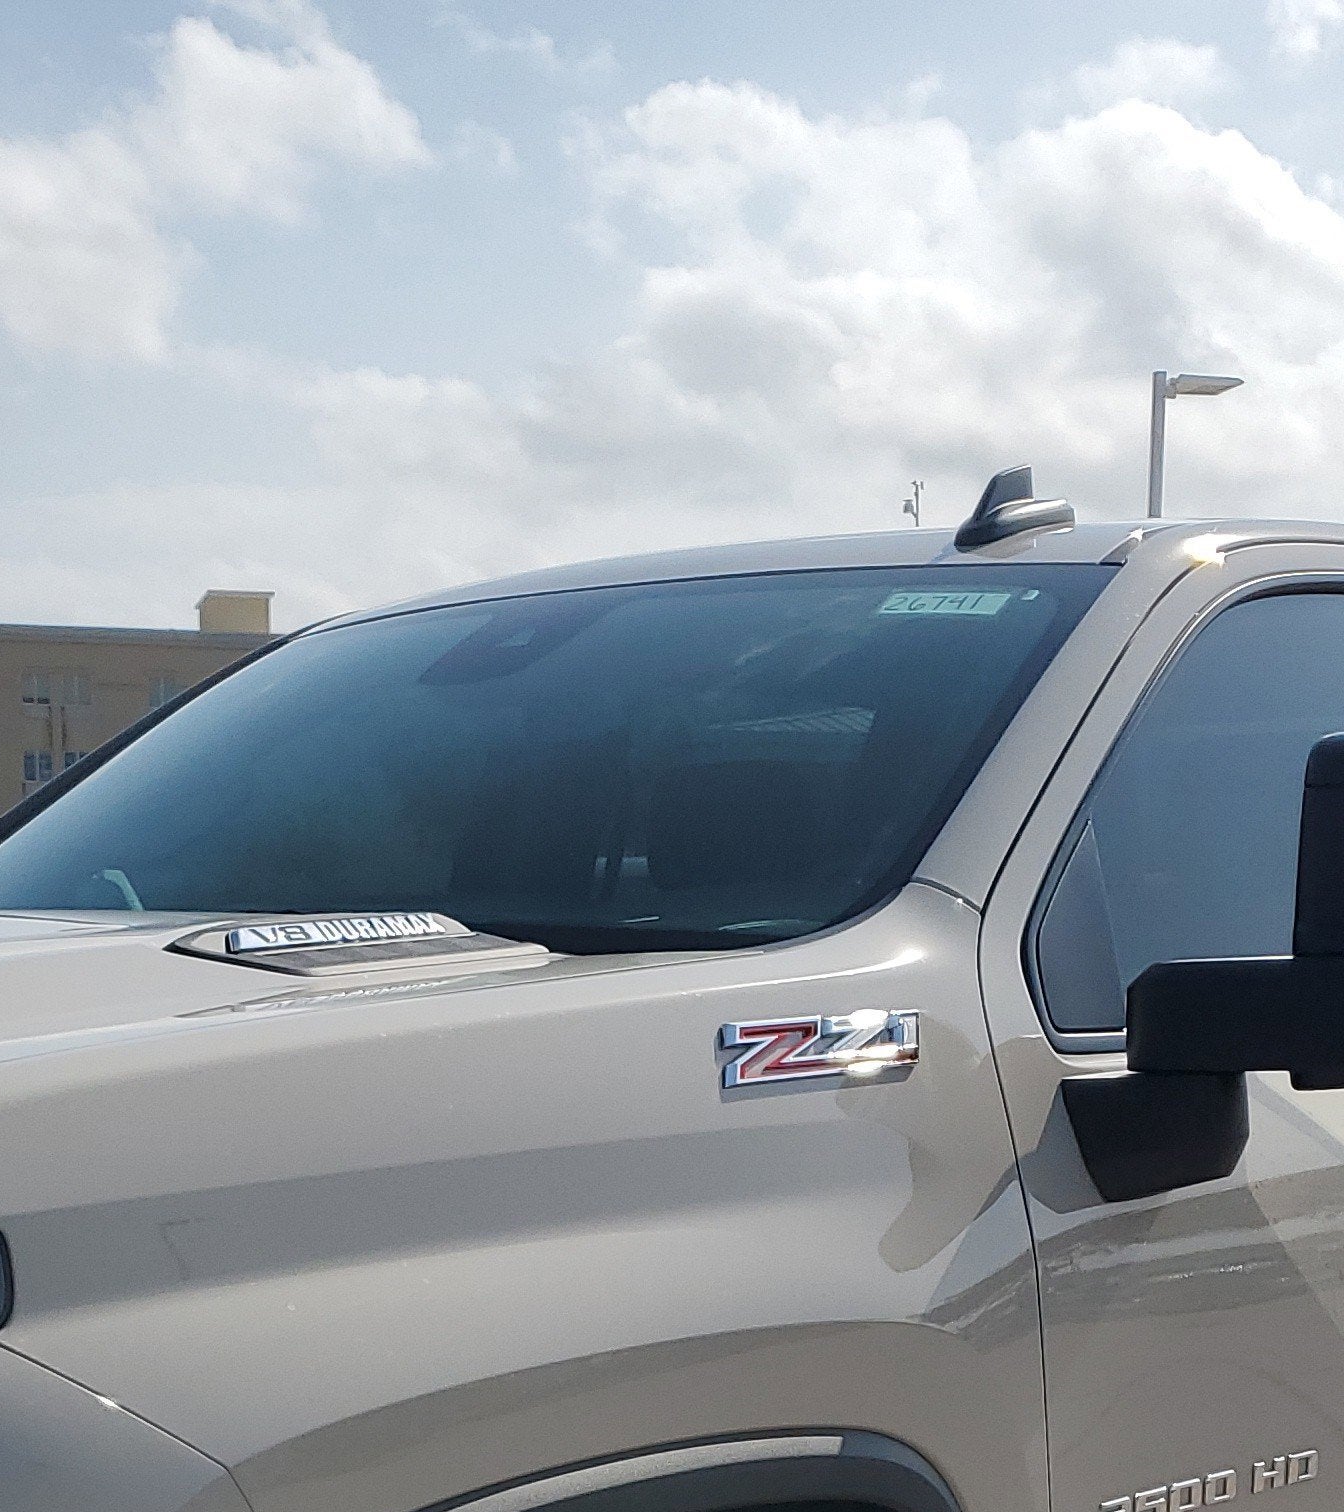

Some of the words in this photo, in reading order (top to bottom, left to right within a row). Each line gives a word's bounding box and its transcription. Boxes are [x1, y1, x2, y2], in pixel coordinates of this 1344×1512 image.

[884, 594, 985, 611] 26741
[249, 924, 312, 944] V8
[314, 912, 446, 942] DURAMAX
[718, 1009, 920, 1089] Z71
[1252, 1450, 1319, 1494] HD
